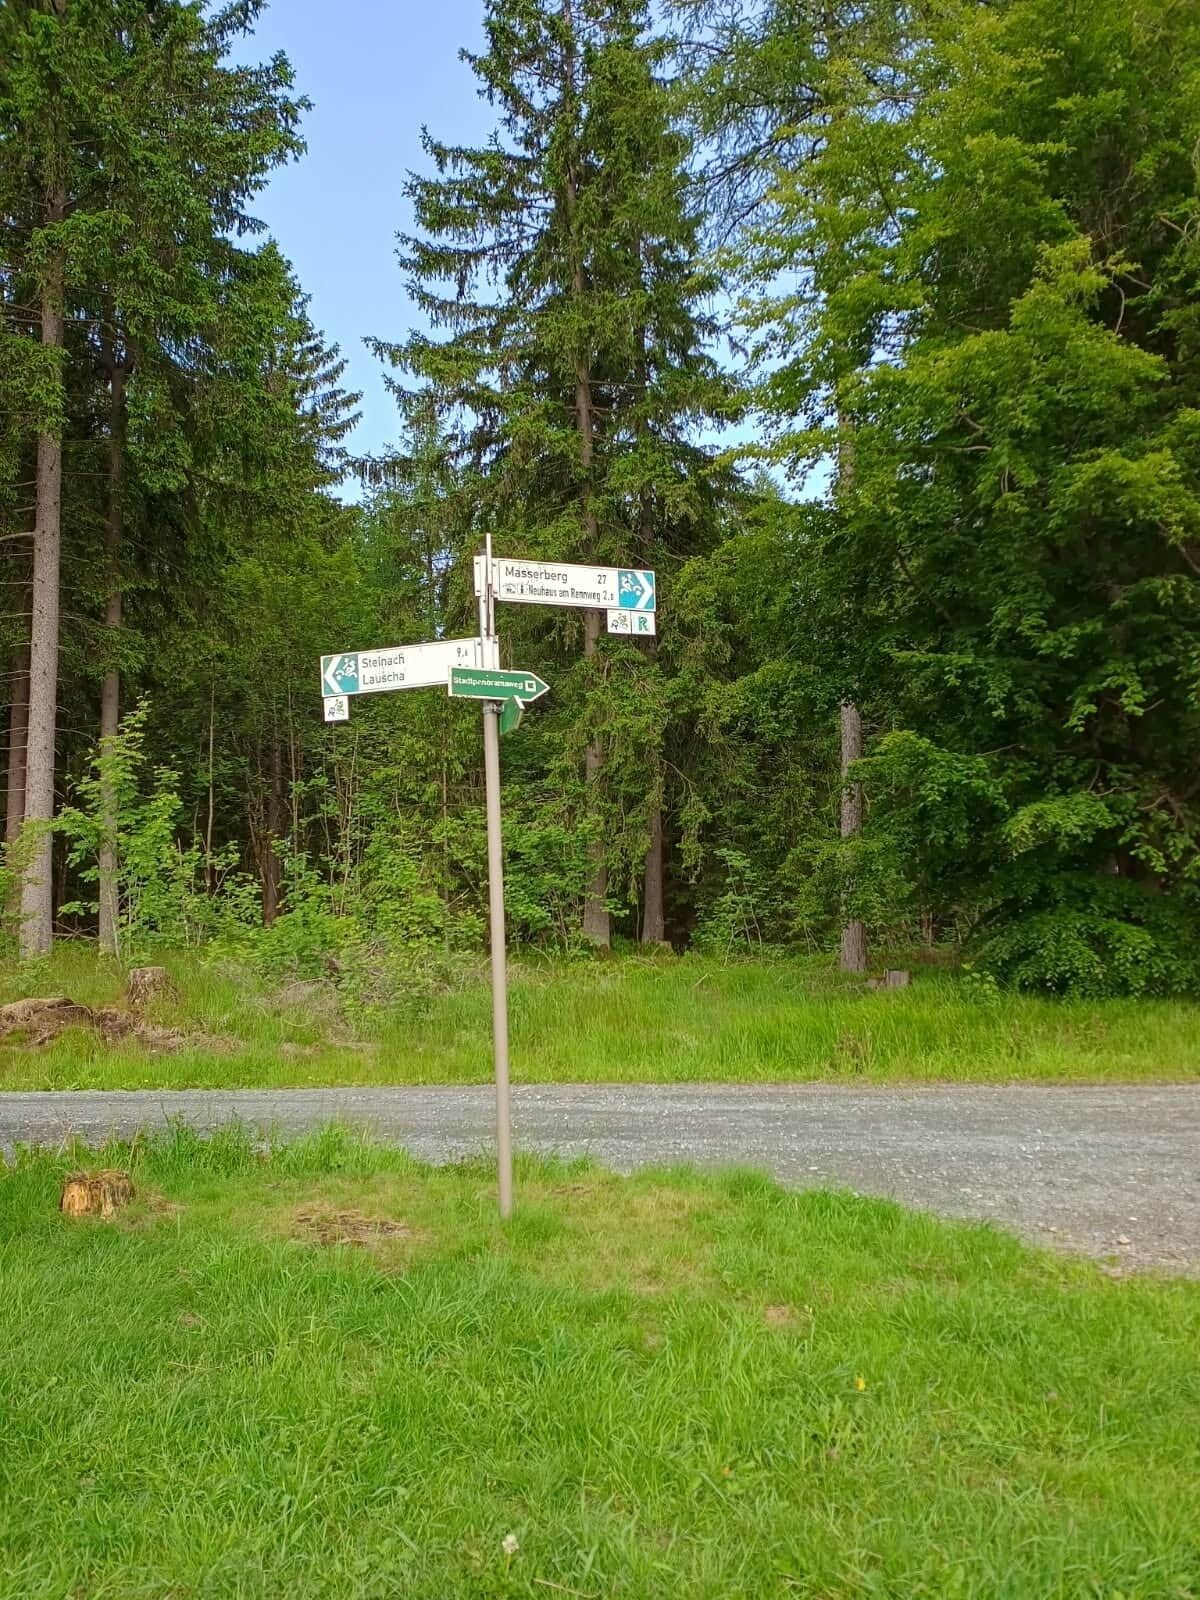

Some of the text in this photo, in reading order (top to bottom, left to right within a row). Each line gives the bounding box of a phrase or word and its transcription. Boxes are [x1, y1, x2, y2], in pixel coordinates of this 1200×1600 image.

[505, 566, 607, 585] Masserberg 27
[528, 584, 557, 598] Neuhaus
[559, 589, 570, 598] am
[570, 587, 601, 602] Rennweg
[362, 653, 405, 669] Steinach
[362, 672, 405, 686] Lauscha
